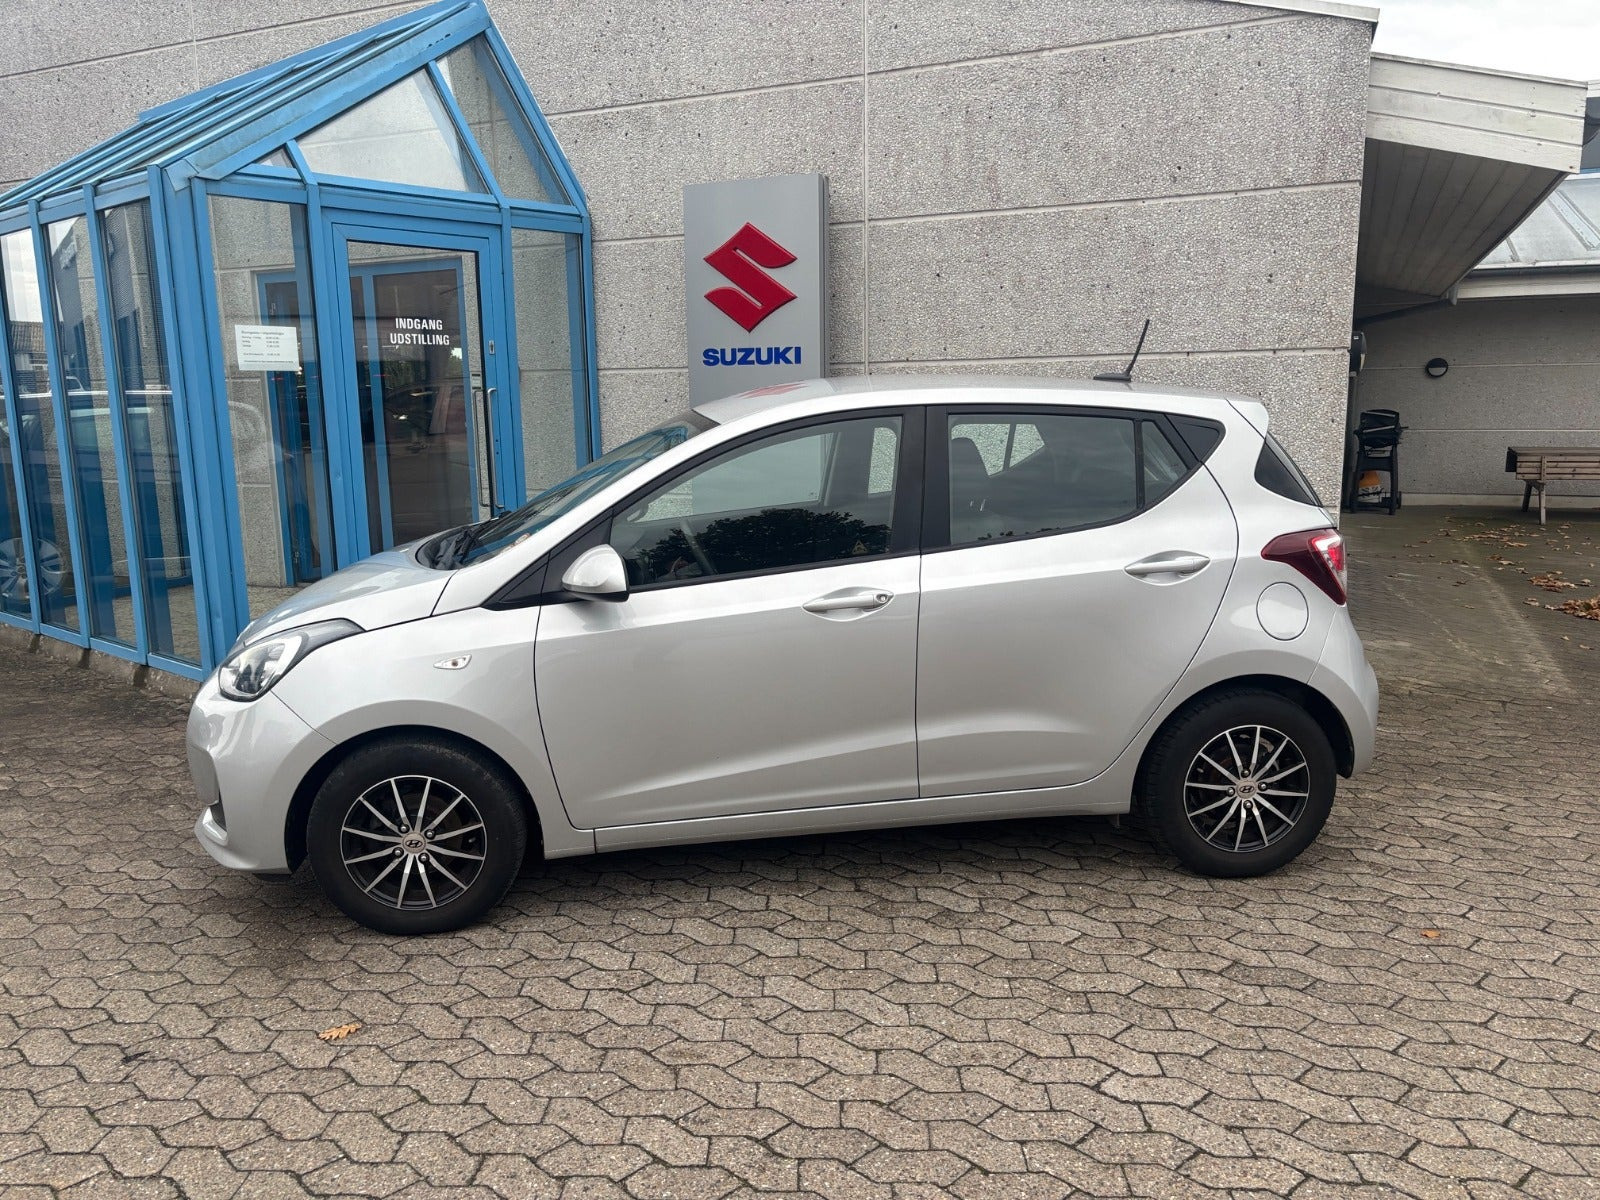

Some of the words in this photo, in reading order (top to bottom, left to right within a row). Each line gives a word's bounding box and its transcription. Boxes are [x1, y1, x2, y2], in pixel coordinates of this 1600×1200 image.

[395, 317, 443, 331] INDGANG
[389, 332, 450, 346] UDSTILLING
[702, 346, 802, 367] SUZUKI
